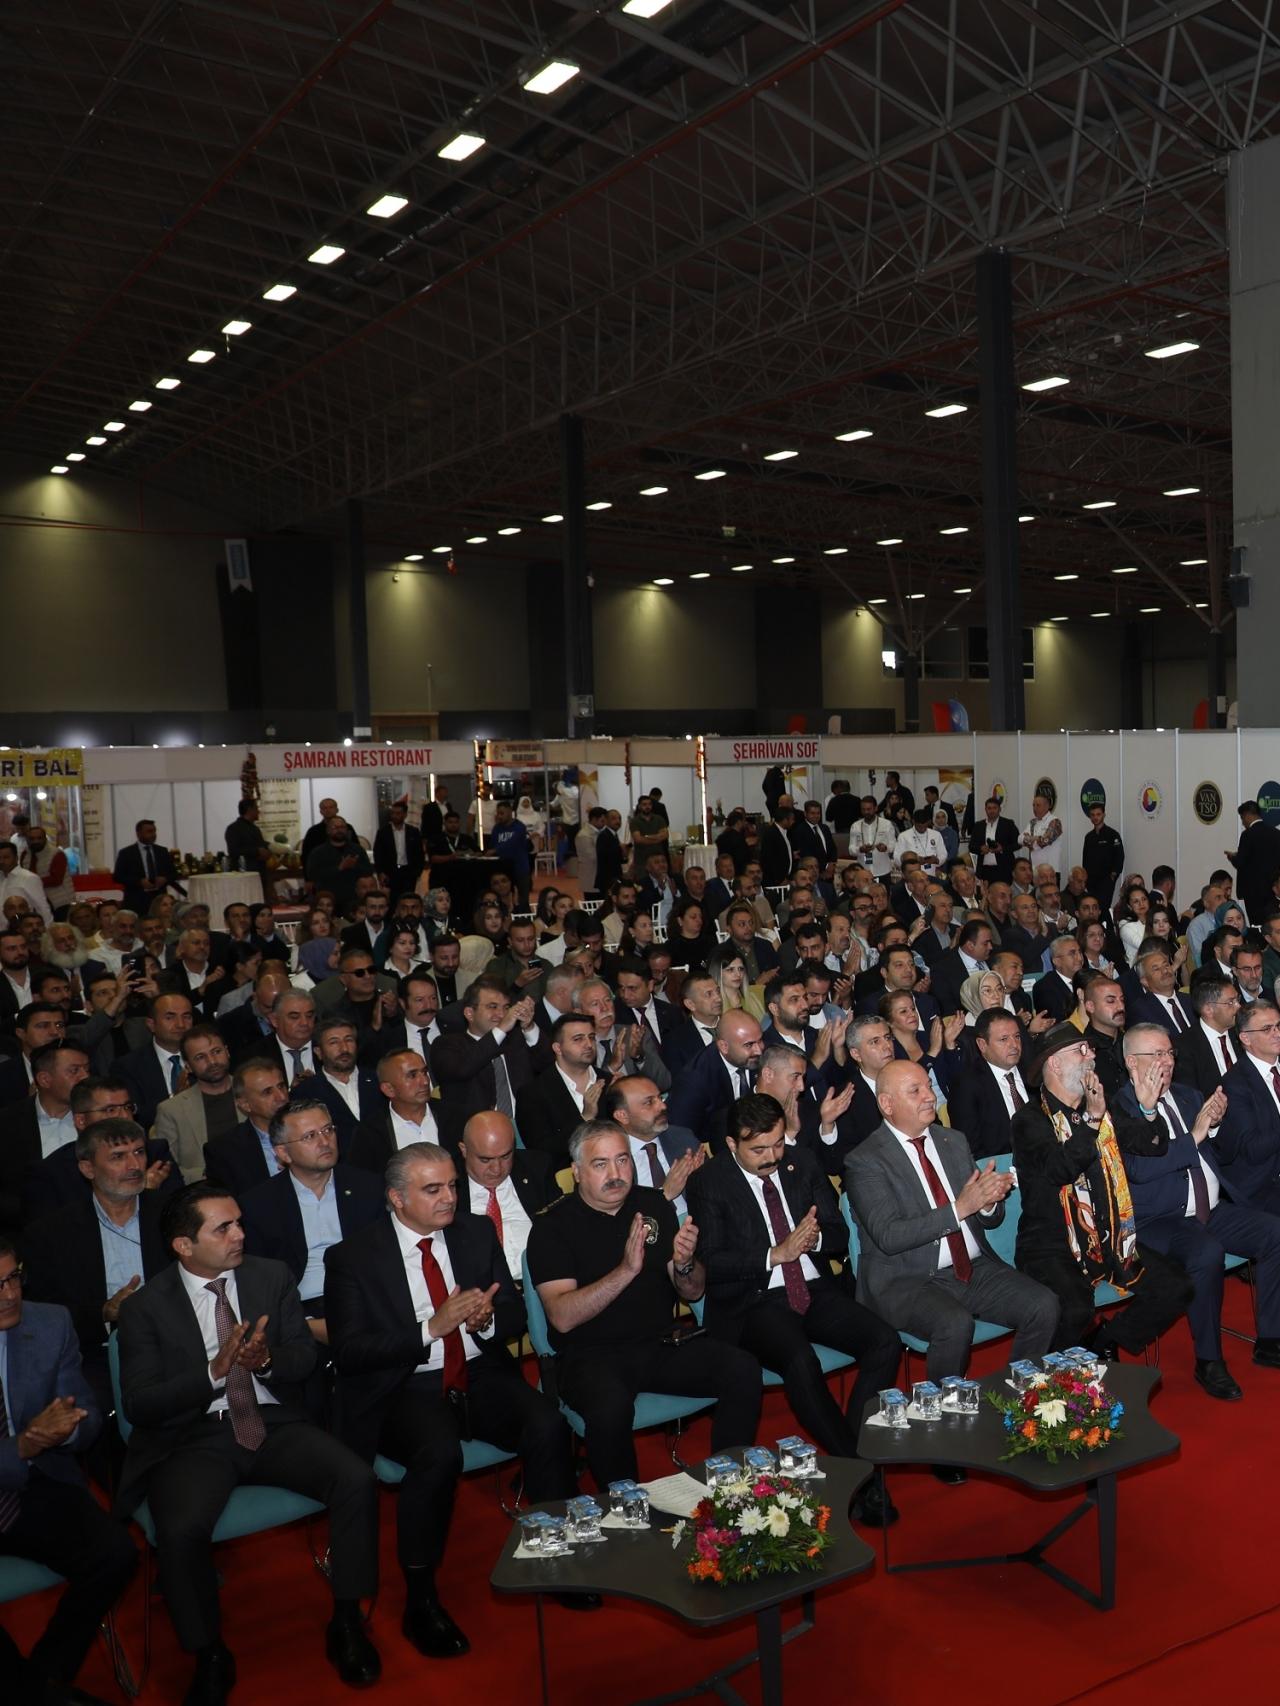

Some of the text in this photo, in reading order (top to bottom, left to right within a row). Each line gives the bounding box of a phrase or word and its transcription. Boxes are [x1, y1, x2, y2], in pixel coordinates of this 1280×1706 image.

[733, 739, 794, 762] ŞEHRİVAN
[34, 759, 78, 777] BAL
[284, 749, 432, 772] ŞAMRAN RESTORANT
[1200, 790, 1216, 802] VAN
[1199, 802, 1217, 814] TSO
